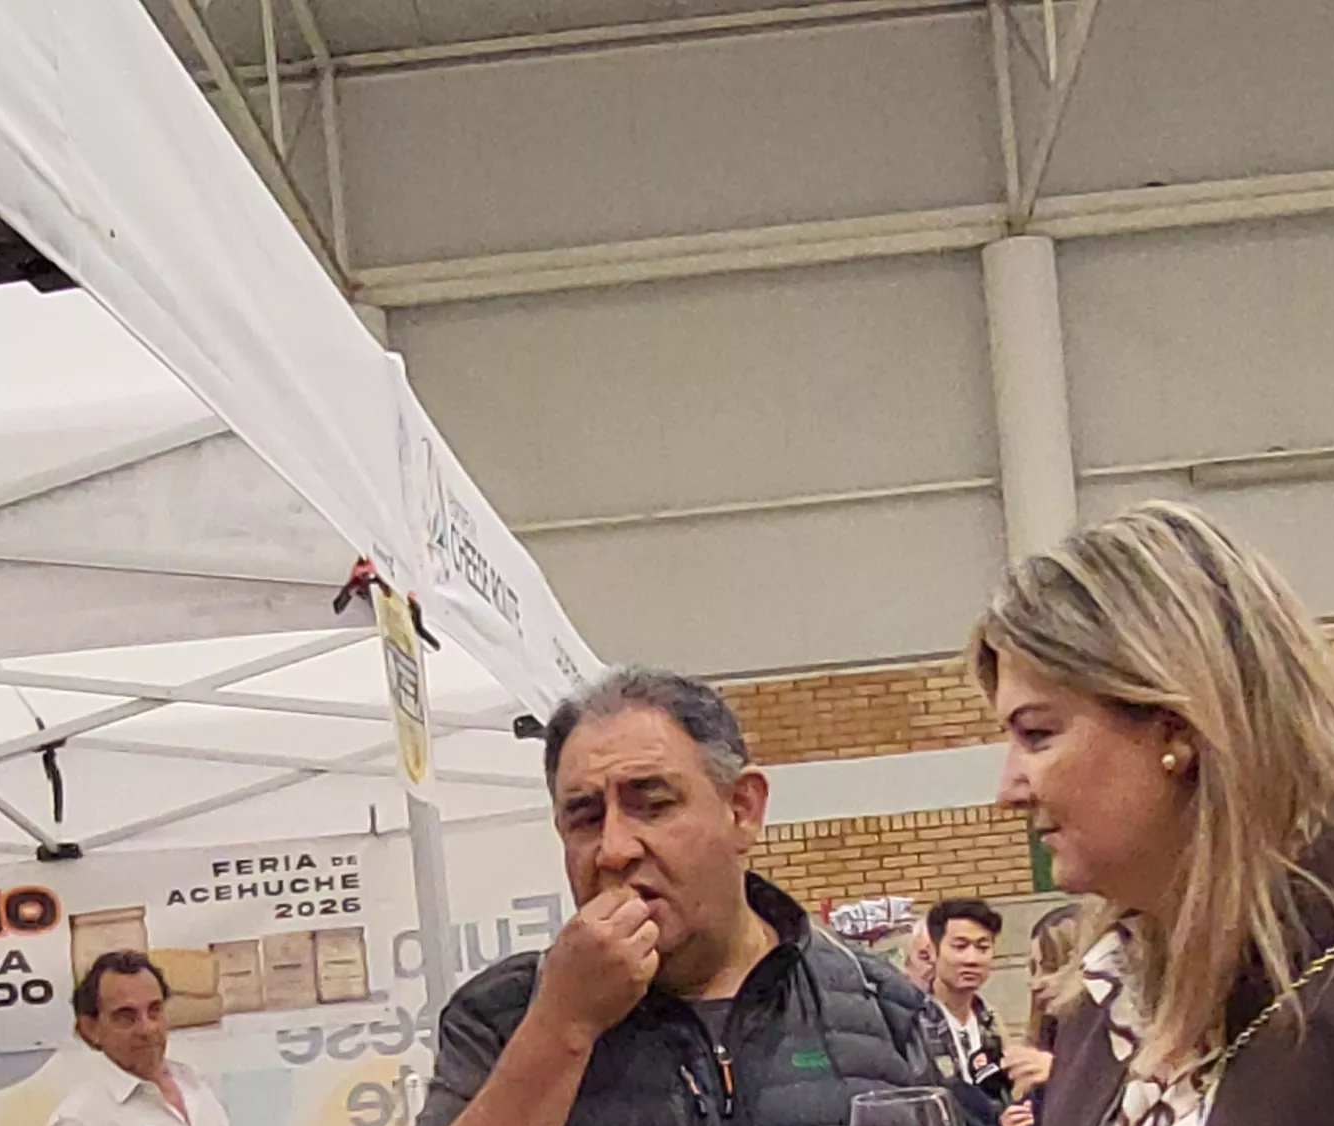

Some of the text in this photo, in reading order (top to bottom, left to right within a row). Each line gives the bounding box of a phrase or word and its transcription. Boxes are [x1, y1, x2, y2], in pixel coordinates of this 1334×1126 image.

[212, 854, 357, 878] FERIA DE
[167, 873, 360, 907] ACEHUCHE
[274, 897, 361, 919] 2026
